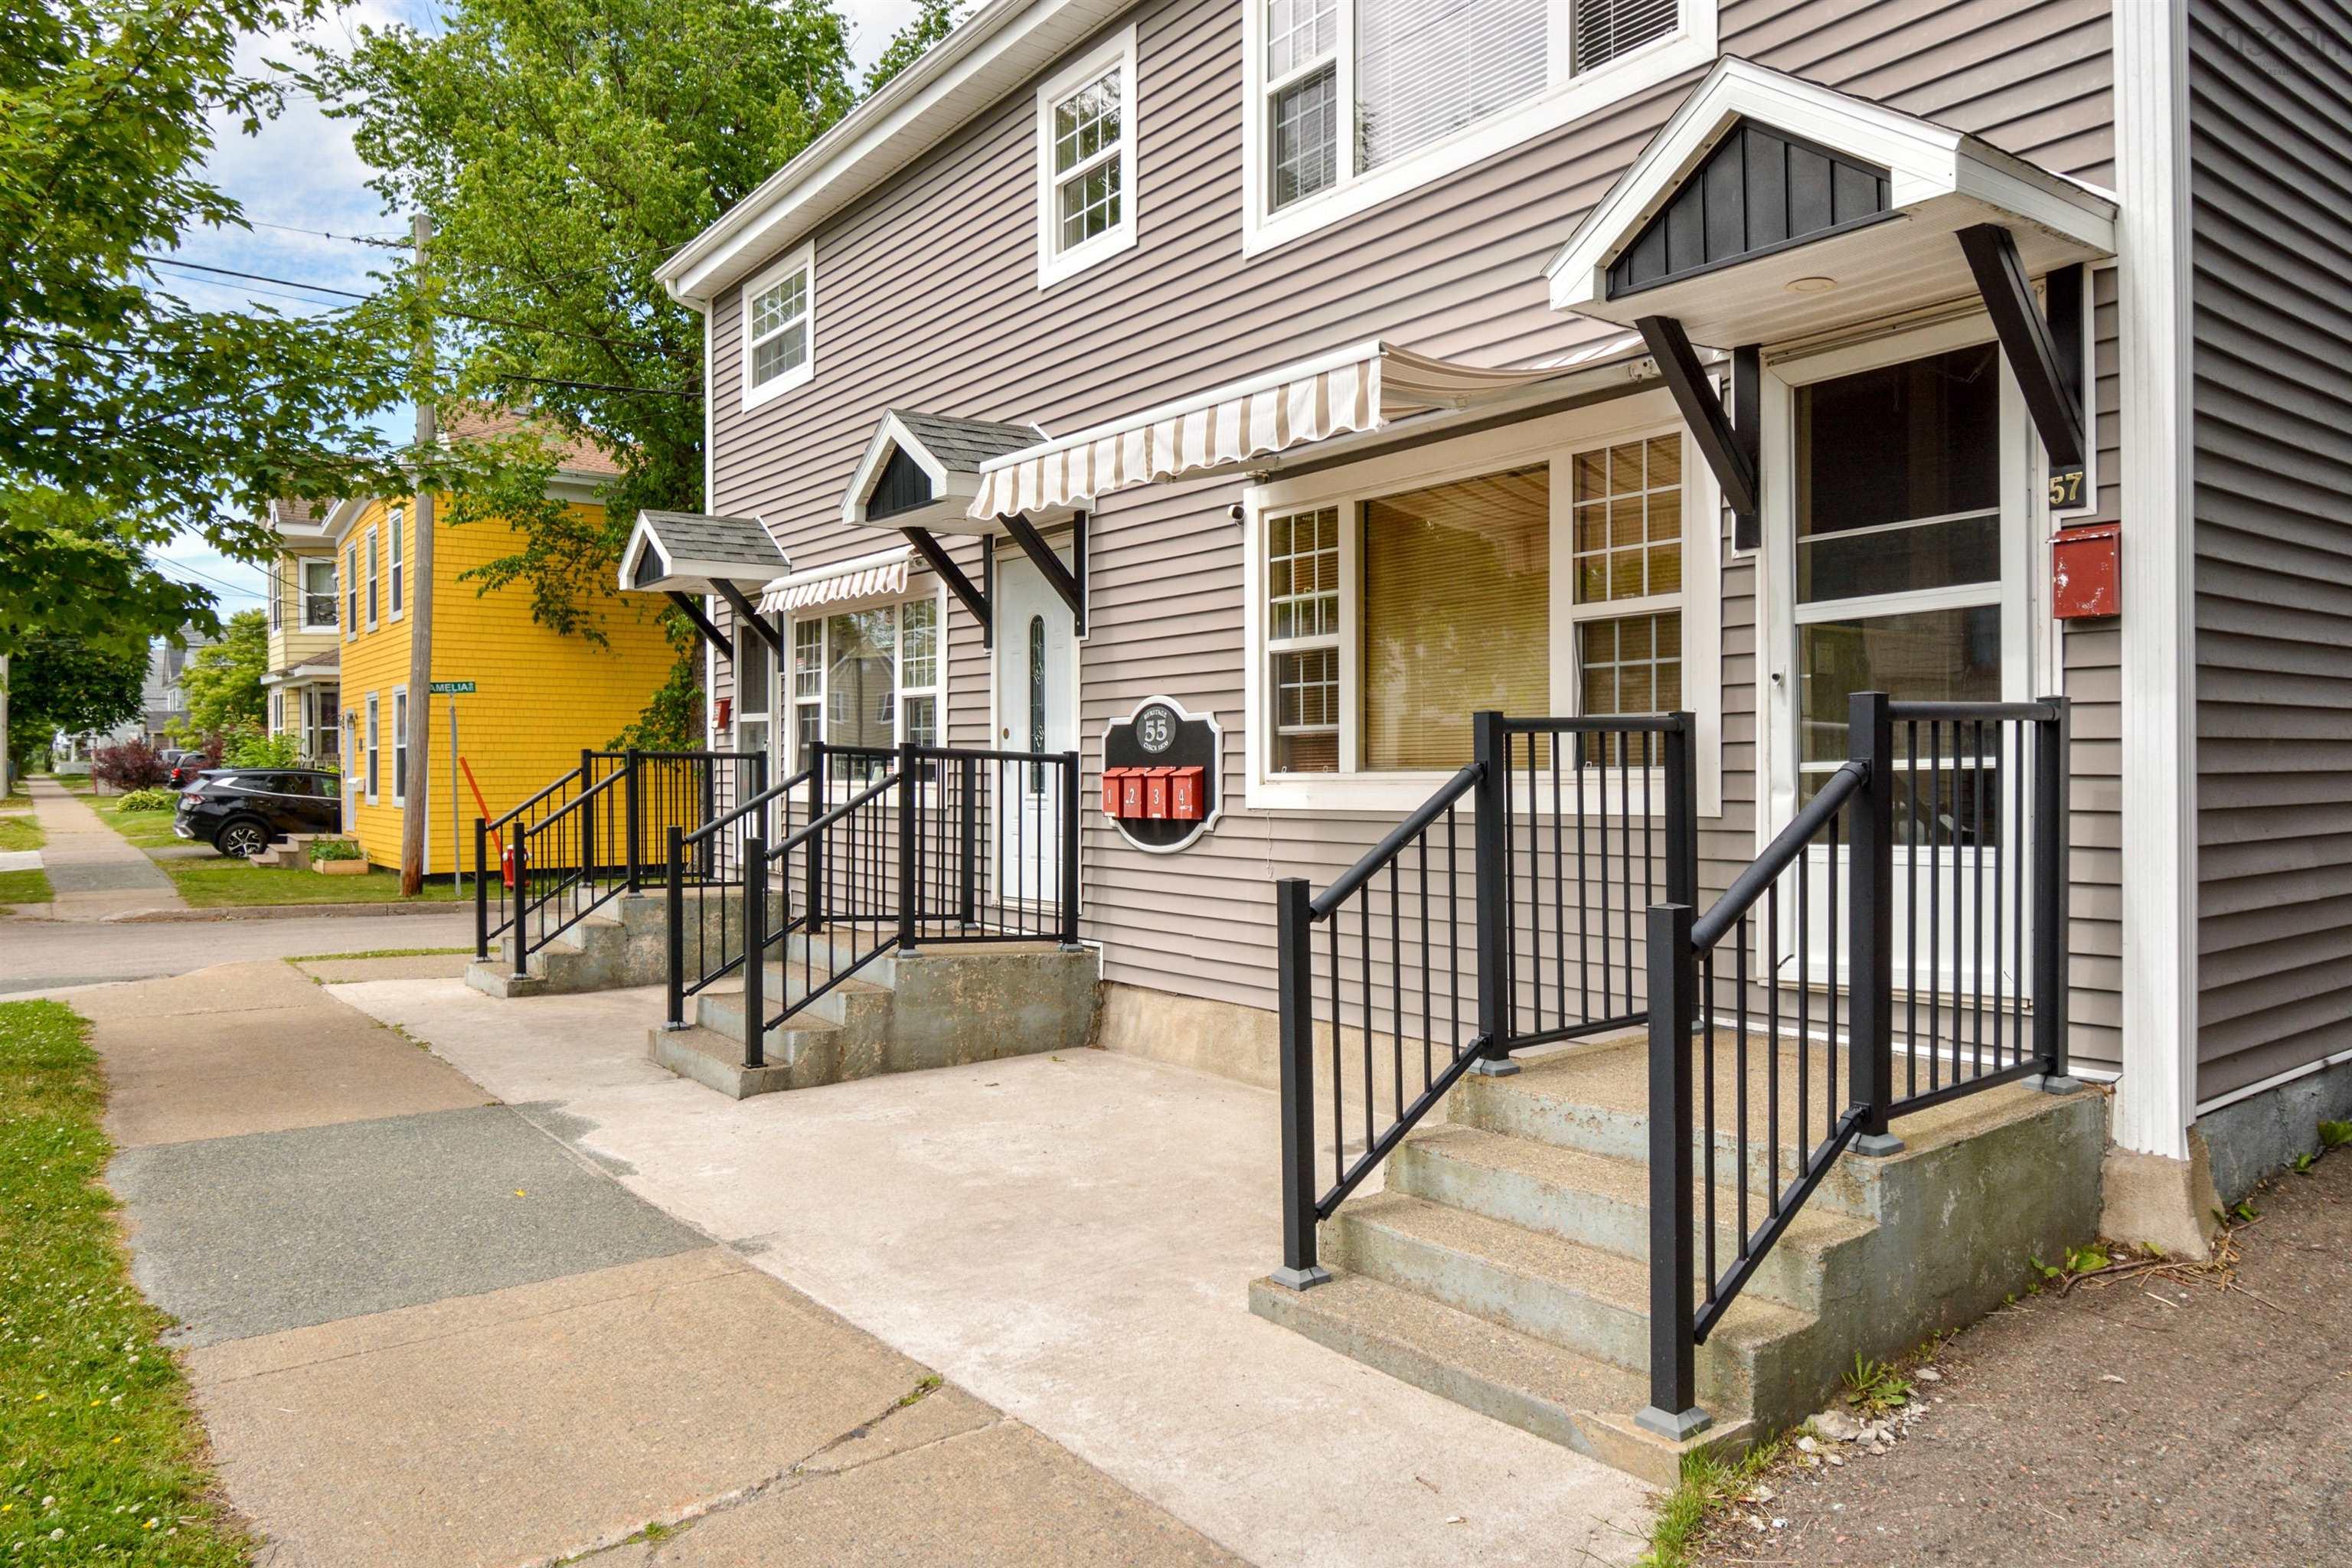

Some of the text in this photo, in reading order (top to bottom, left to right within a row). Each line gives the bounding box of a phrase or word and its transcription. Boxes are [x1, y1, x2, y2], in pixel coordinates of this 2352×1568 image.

[2050, 471, 2083, 505] 57
[430, 683, 468, 692] AMELIA
[1145, 720, 1167, 742] 55
[1107, 789, 1112, 804] 1
[1129, 788, 1135, 804] 2
[1154, 789, 1159, 804] 3
[1179, 789, 1184, 805] 4
